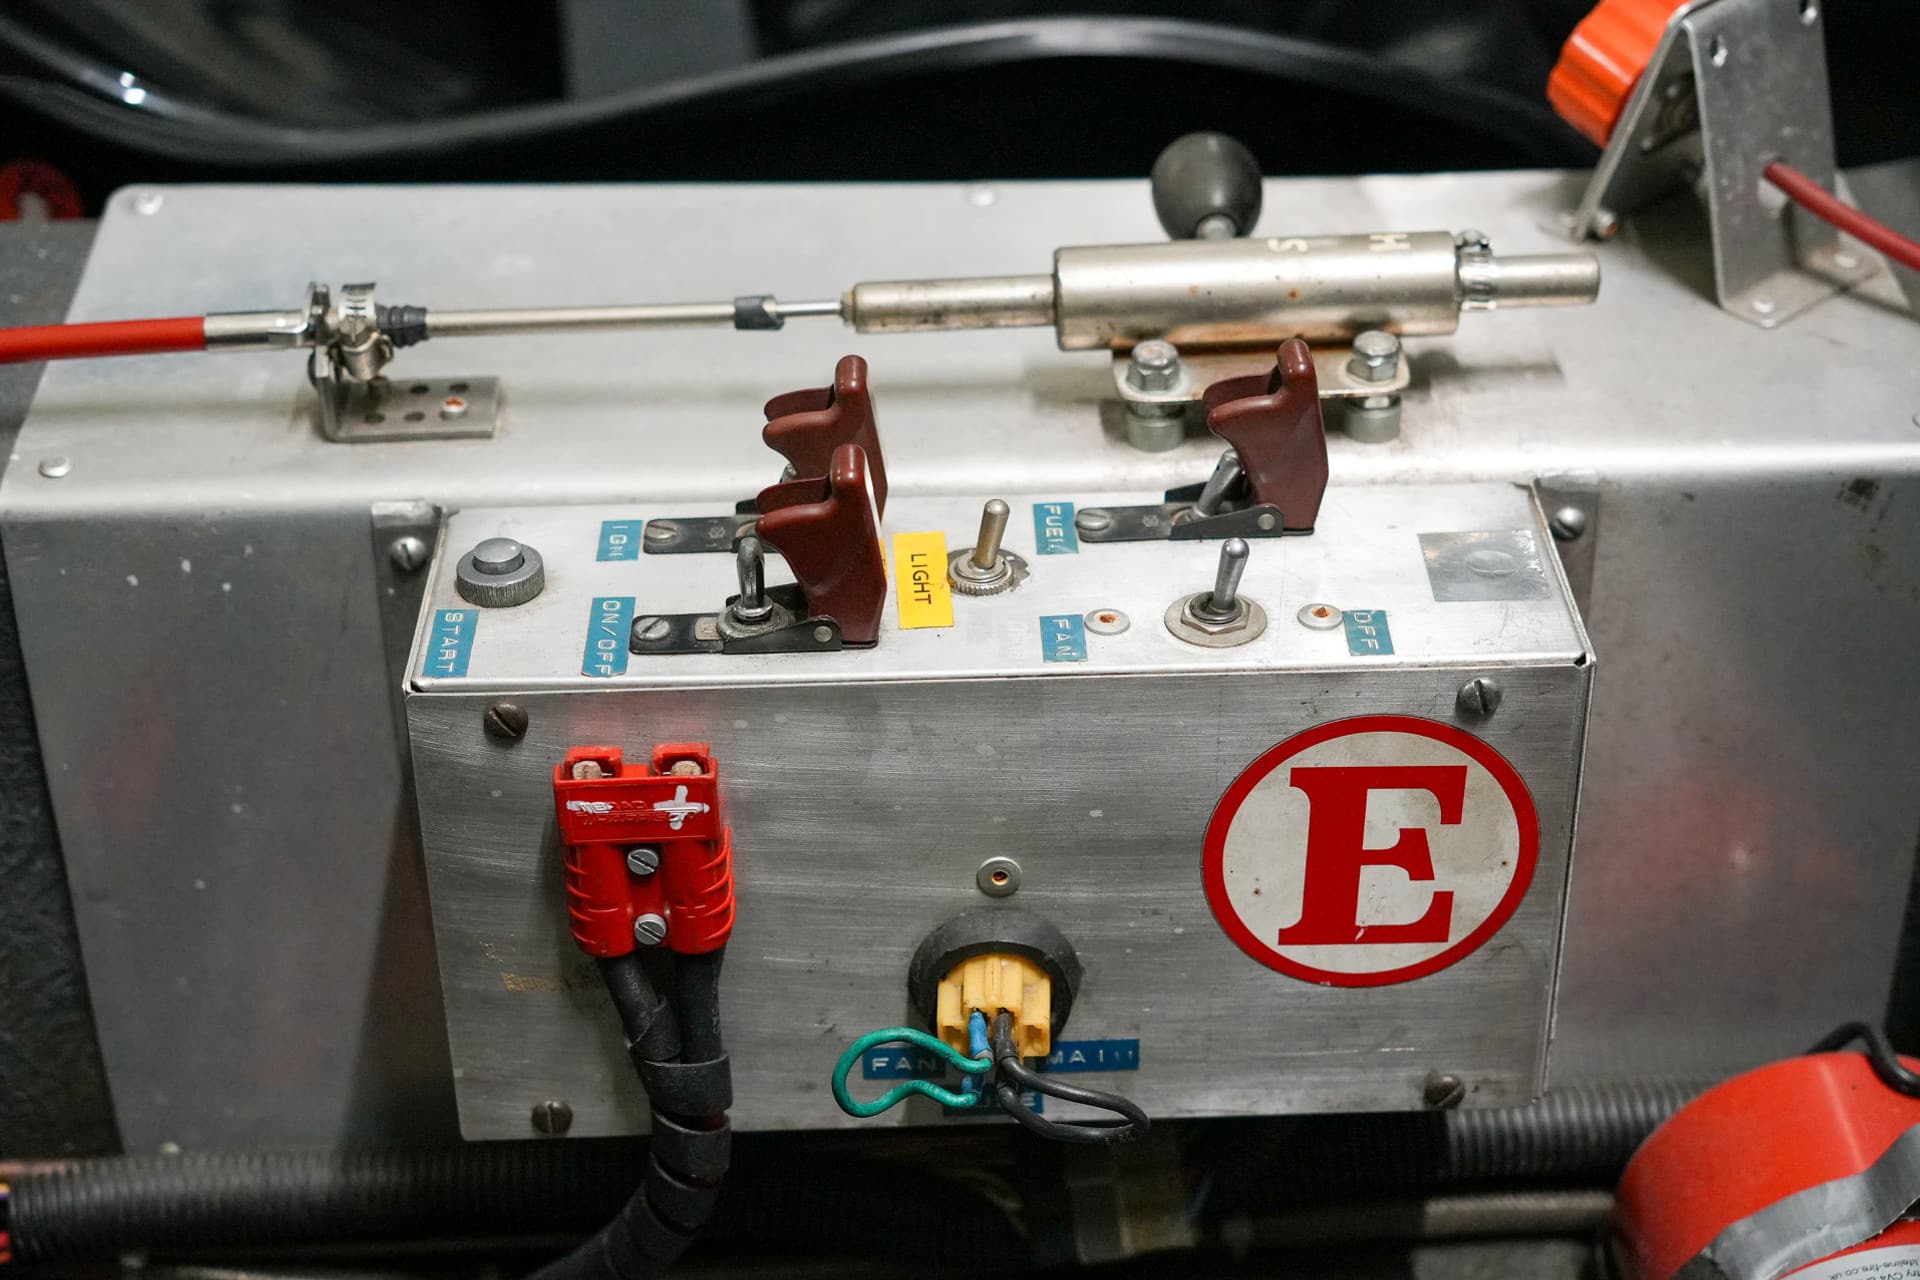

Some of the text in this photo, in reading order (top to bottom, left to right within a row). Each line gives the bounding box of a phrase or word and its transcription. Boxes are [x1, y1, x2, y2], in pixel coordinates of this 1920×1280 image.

[608, 525, 629, 558] IGN
[911, 553, 932, 605] LIGHT
[435, 612, 464, 673] START
[594, 600, 622, 676] ON/OFF
[1052, 618, 1076, 657] FAN
[1353, 612, 1379, 650] OFF
[1278, 765, 1468, 946] E
[871, 1056, 936, 1072] FAN
